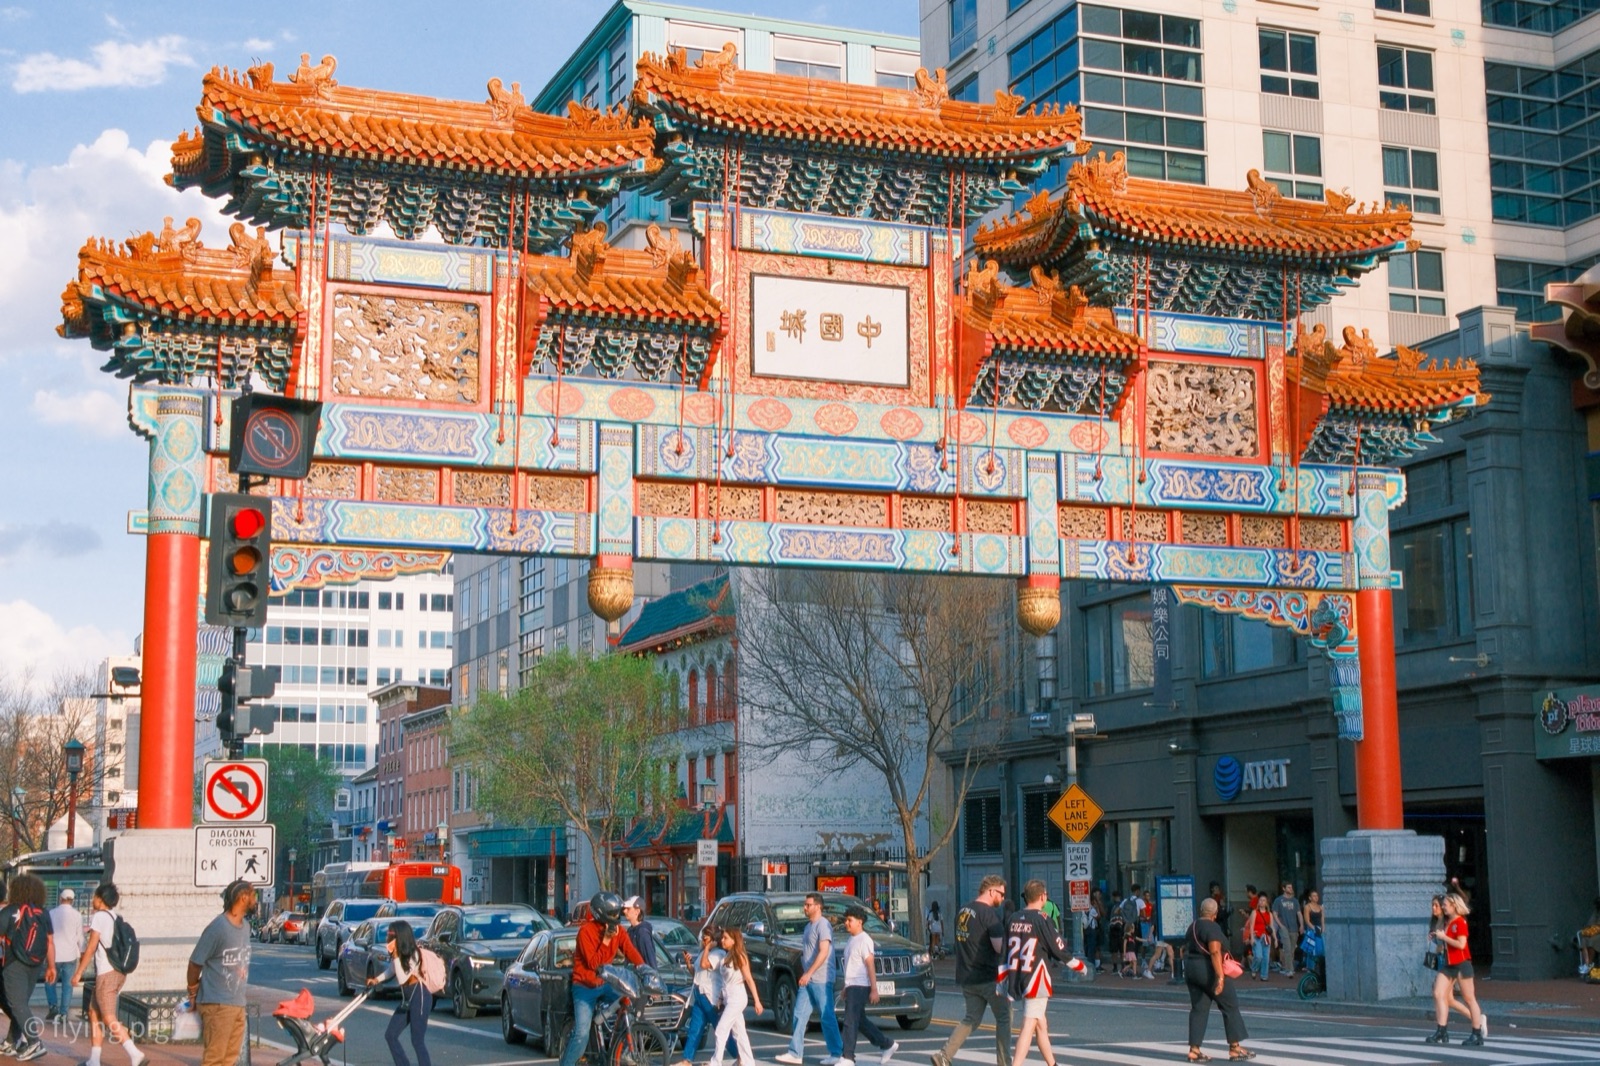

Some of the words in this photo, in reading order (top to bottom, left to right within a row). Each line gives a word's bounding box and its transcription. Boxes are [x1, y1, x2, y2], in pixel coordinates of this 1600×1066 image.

[1241, 758, 1291, 791] AT&T
[1065, 799, 1086, 809] LEFT
[1064, 811, 1088, 820] LANE
[1066, 822, 1089, 832] ENDS
[210, 829, 257, 838] DIAGONAL
[209, 838, 255, 847] CROSSING
[1067, 846, 1090, 854] SPEED
[1069, 862, 1088, 876] 25
[1008, 936, 1038, 972] 24
